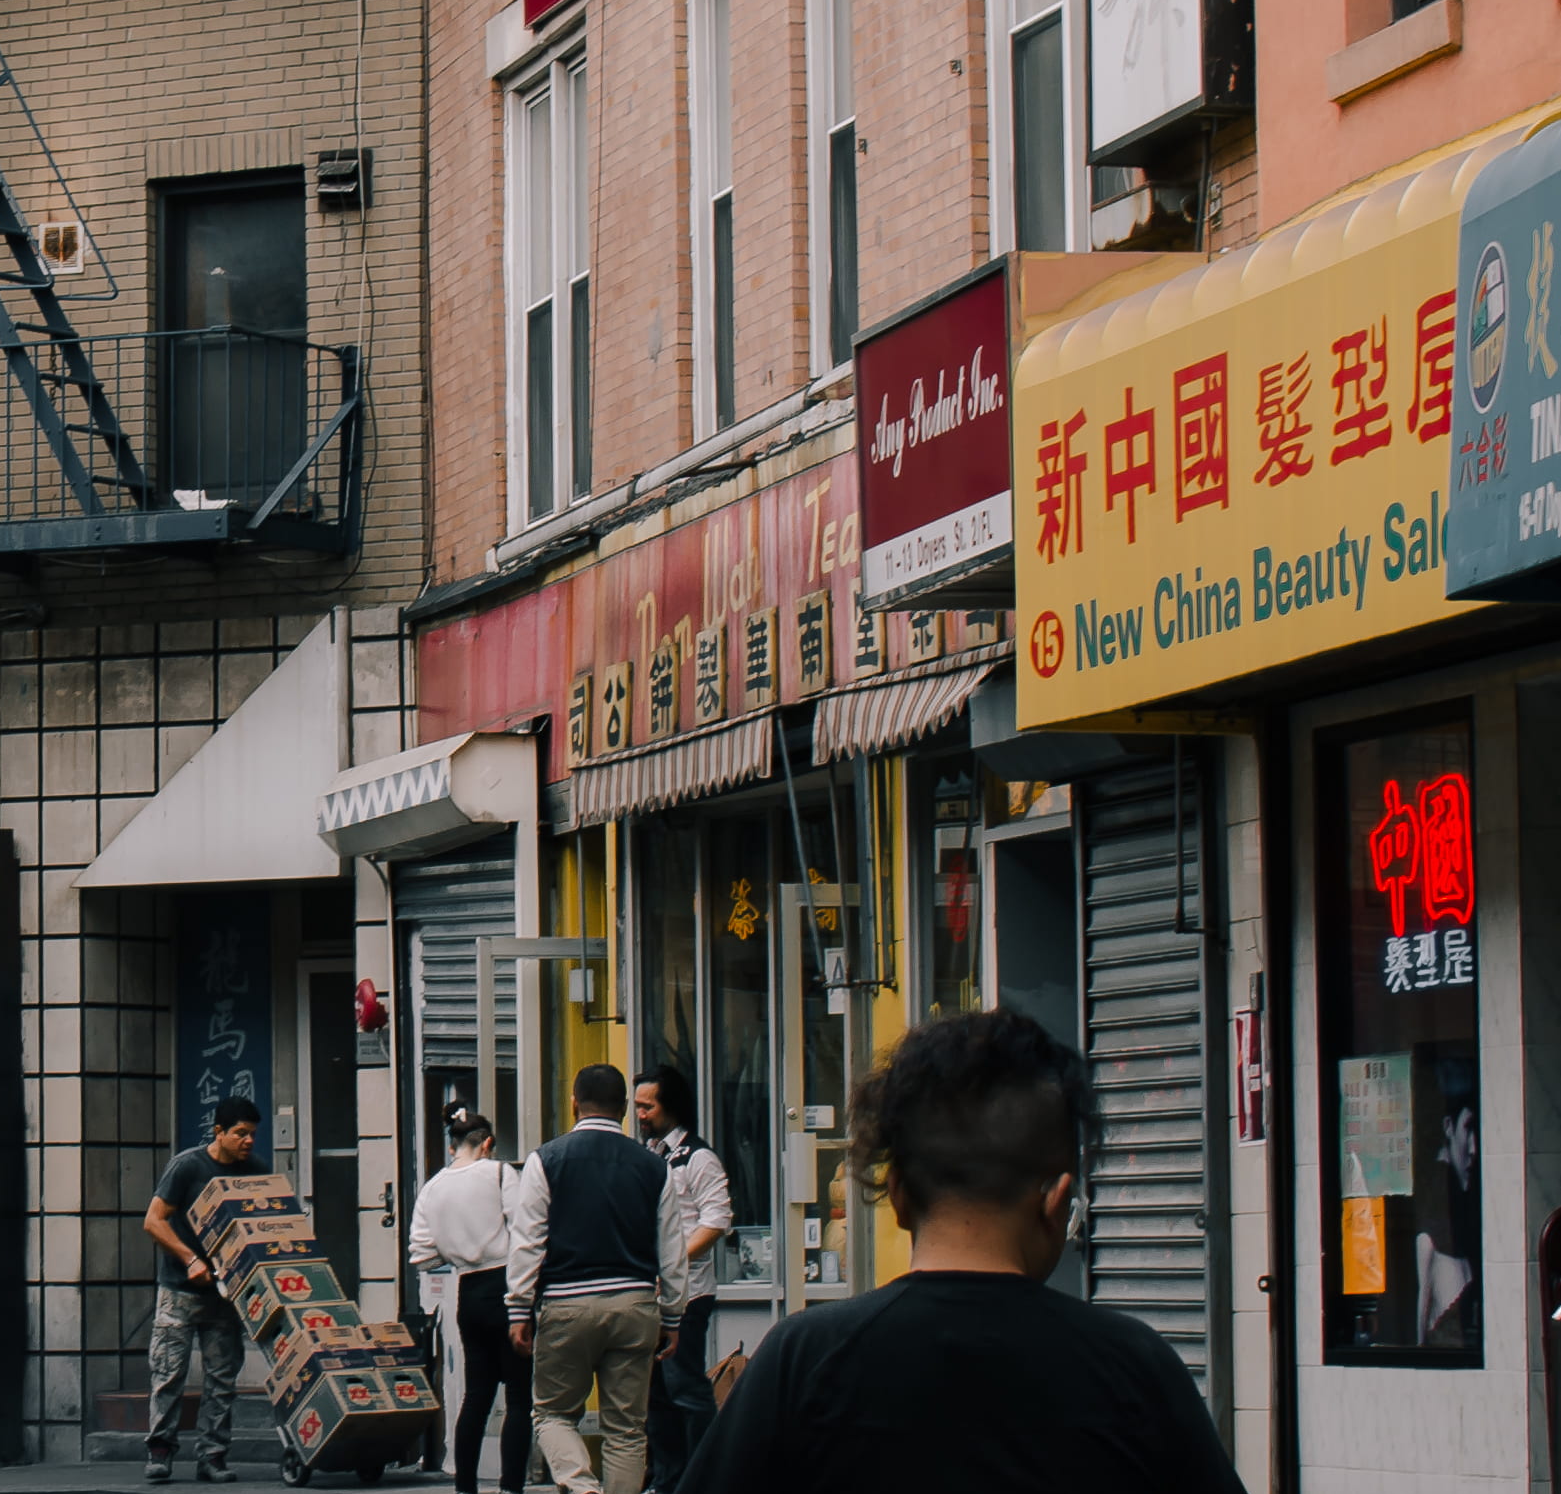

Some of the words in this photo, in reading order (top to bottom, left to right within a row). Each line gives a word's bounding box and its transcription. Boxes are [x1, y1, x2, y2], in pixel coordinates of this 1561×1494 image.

[871, 393, 906, 478] Any
[908, 365, 966, 448] Product
[968, 345, 1004, 421] Inc.
[917, 532, 947, 573] Doyers
[1075, 598, 1144, 672] New
[1154, 567, 1241, 650] China
[1254, 525, 1371, 623] Beauty
